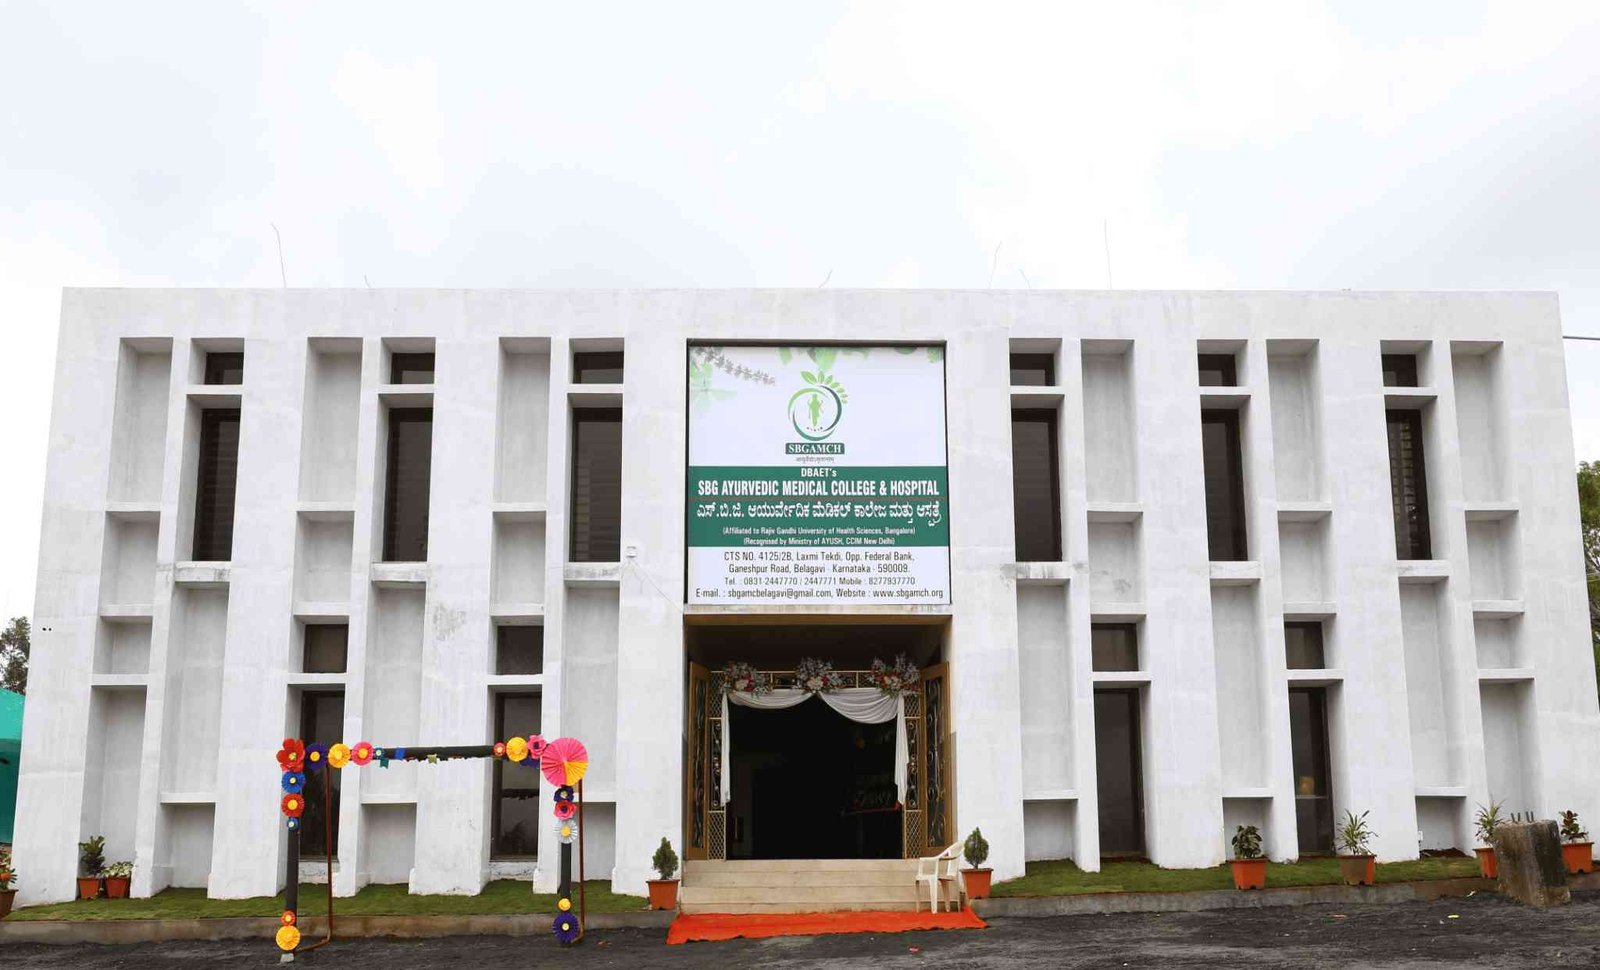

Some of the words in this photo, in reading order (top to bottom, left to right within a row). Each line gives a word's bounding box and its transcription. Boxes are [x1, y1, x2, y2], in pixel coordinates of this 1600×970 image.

[788, 443, 841, 454] SBGAMCH
[801, 467, 837, 477] DBAET's
[698, 480, 718, 496] SBG
[721, 480, 779, 496] AYURVEDIC
[782, 480, 828, 496] MEDICAL
[831, 480, 876, 496] COLLEGE
[879, 480, 887, 496] &
[890, 480, 939, 496] HOSPITAL
[889, 501, 913, 523] ಮತ್ತು
[722, 526, 752, 535] (Affiliated
[753, 527, 759, 535] to
[760, 527, 775, 536] Rajiv
[776, 527, 797, 535] Gandhi
[798, 527, 827, 536] University
[828, 527, 835, 535] of
[836, 527, 855, 535] Health
[743, 537, 778, 546] (Recognised
[780, 537, 786, 546] by
[788, 537, 812, 546] Ministry
[813, 537, 820, 545] of
[845, 537, 862, 545] CCIM
[863, 537, 877, 545] New
[724, 551, 740, 561] CTS
[742, 551, 756, 561] NO.
[796, 551, 818, 561] Laxmi
[845, 551, 862, 562] Opp.
[864, 551, 892, 561] Federal
[893, 551, 915, 562] Bank,
[728, 564, 768, 574] Ganeshpur
[770, 564, 791, 574] Road,
[794, 564, 825, 575] Belagavi
[832, 564, 871, 573] Karnataka
[804, 577, 836, 586] 2447771
[839, 577, 862, 585] Mobile
[868, 577, 915, 586] 8277937770
[835, 588, 866, 598] Website
[872, 588, 943, 599] www.sbgamch.org
